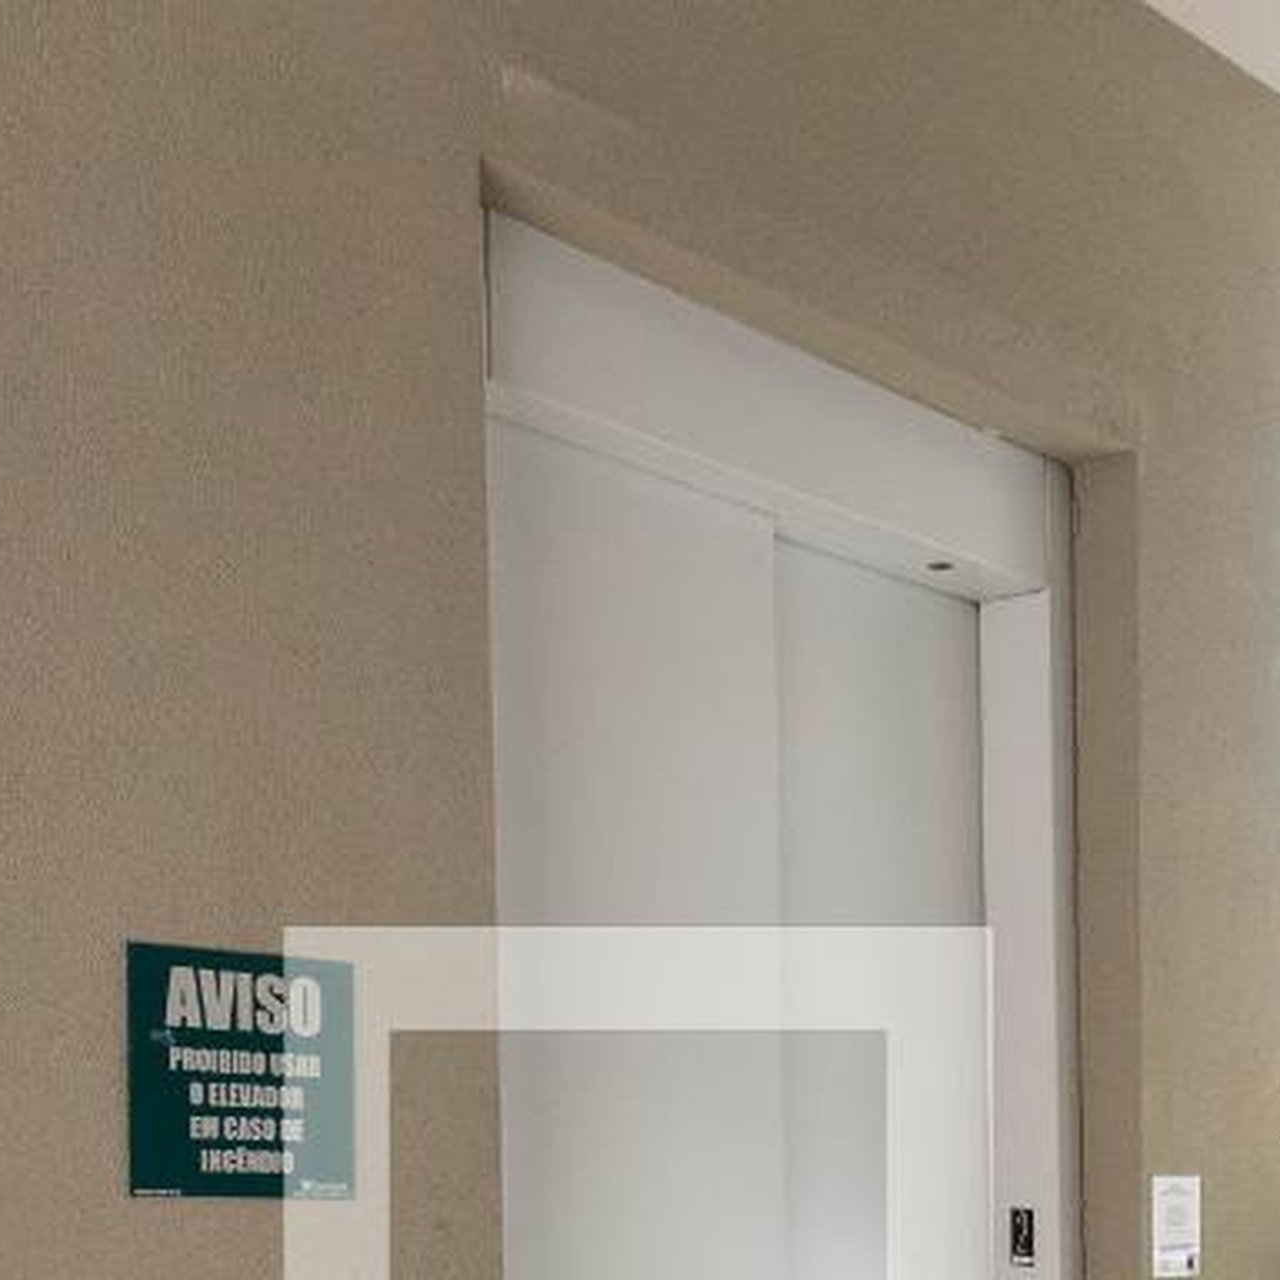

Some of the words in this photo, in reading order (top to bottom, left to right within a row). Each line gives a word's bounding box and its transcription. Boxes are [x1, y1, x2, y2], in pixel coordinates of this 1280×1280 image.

[166, 965, 321, 1037] AVISO
[168, 1046, 267, 1076] PROIBIDO
[271, 1052, 321, 1078] USAR
[188, 1082, 204, 1105] O
[208, 1082, 305, 1111] ELEVADOR
[189, 1115, 220, 1140] EM
[223, 1115, 277, 1142] CASO
